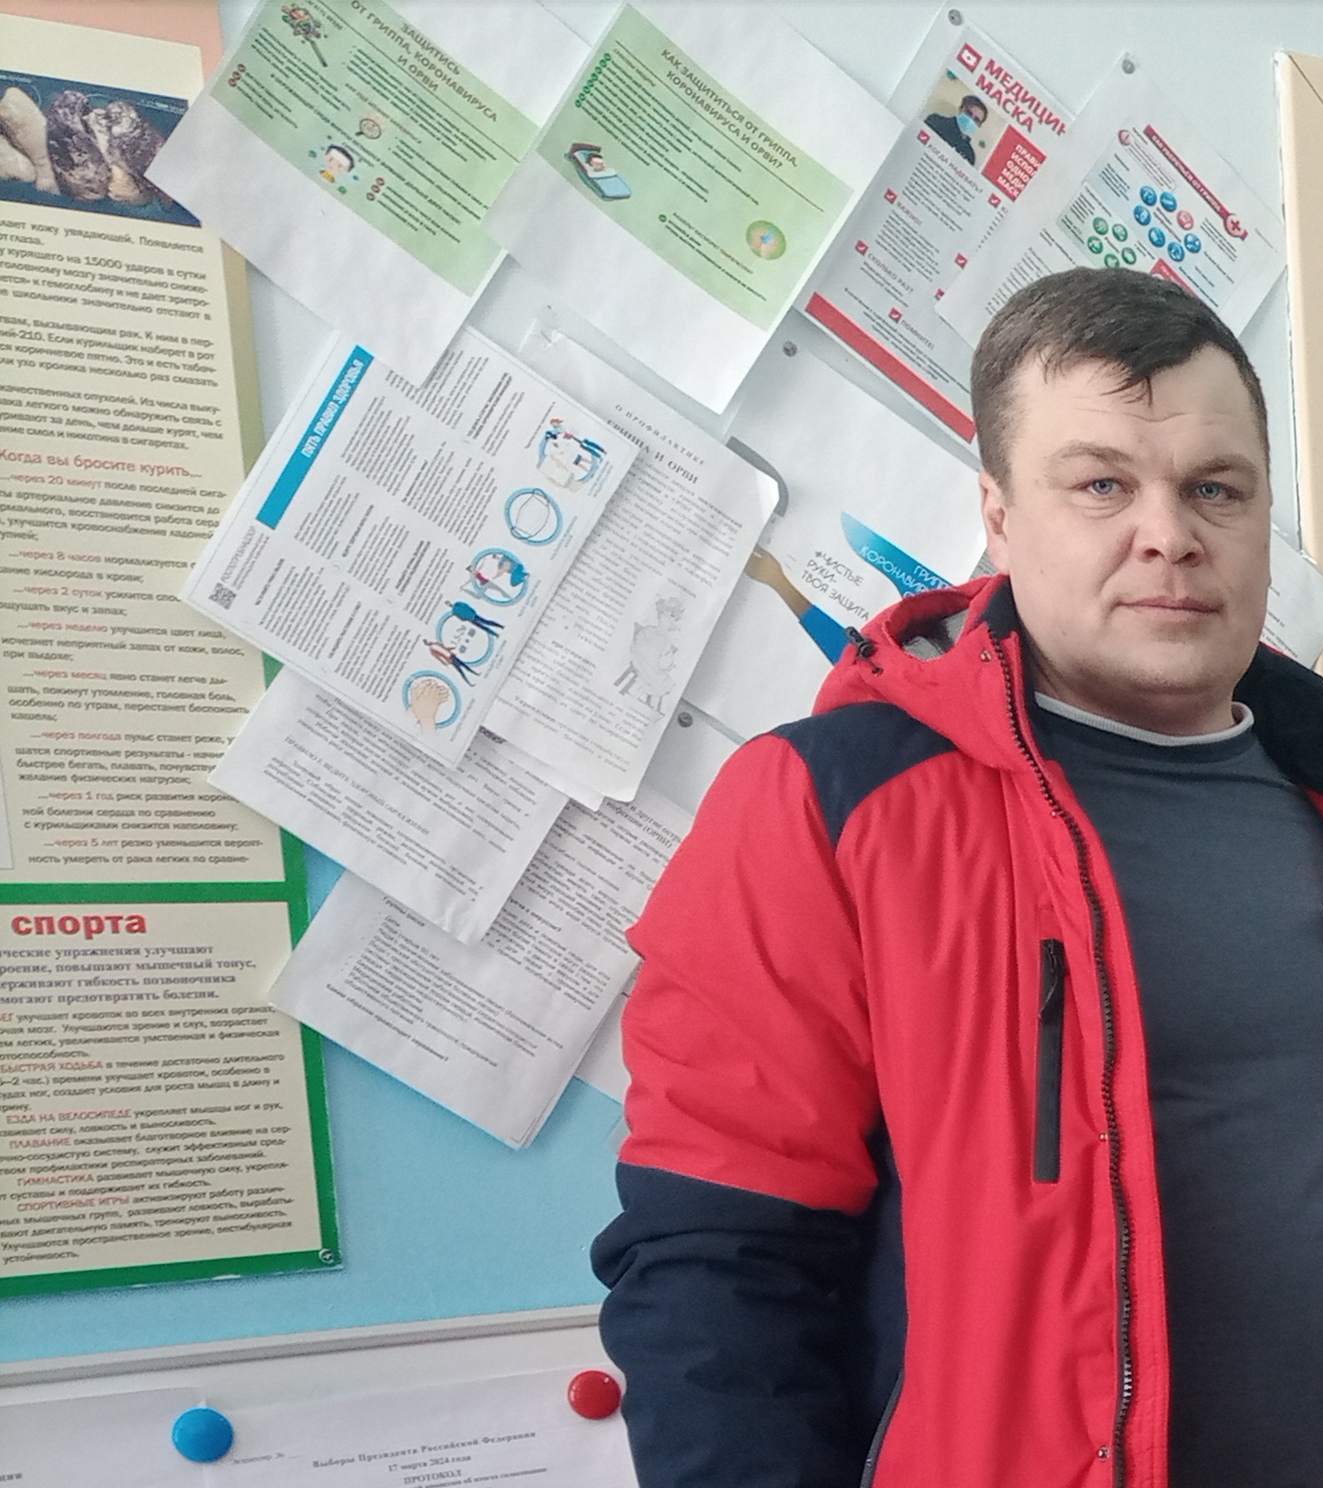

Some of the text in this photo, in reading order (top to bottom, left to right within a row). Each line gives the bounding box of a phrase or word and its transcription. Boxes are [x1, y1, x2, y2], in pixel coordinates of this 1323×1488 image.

[351, 0, 497, 122] ОТ ГРИППА, КОРОНАВИРУСА
[400, 23, 460, 76] ЗАЩИТИСЬ
[398, 55, 439, 91] И ОРВИ
[662, 49, 798, 168] КАК ЗАЩИТИТЬСЯ ОТ ГРИППА,
[976, 73, 1034, 134] МАСКА
[666, 71, 783, 169] КОРОНАВИРУСА И ОРВИ?
[84, 256, 122, 270] 15000
[301, 359, 365, 458] ПЯТЬ ПРАВИЛ ЗДОРОВЬЯ
[615, 404, 622, 412] О
[0, 450, 42, 464] Когда
[47, 455, 69, 465] вы
[74, 456, 136, 472] бросите
[655, 452, 664, 461] И
[668, 461, 698, 484] ОРВИ
[861, 546, 931, 593] КОРОНАВИР
[914, 566, 954, 589] ГРИПП
[801, 570, 869, 620] ТВОЯ ЗАЩИТА
[11, 913, 147, 940] спорта
[55, 946, 213, 960] упражнения улучшают
[55, 959, 256, 973] повышают мышечный тонус,
[78, 974, 236, 988] гибкость позвоночника
[58, 989, 219, 1005] предотвратить болезни.
[0, 1060, 102, 1073] БЫСТРАЯ ХОДЬБА
[7, 1109, 131, 1124] ЕЗДА НА ВЕЛОСИПЕДЕ
[9, 1137, 71, 1150] ПЛАВАНИЕ
[18, 1173, 94, 1187] ГИМНАСТИКА
[312, 1431, 536, 1468] Выборы Президента Российской Федерации
[404, 1470, 462, 1485] ПРОТОКОЛ
